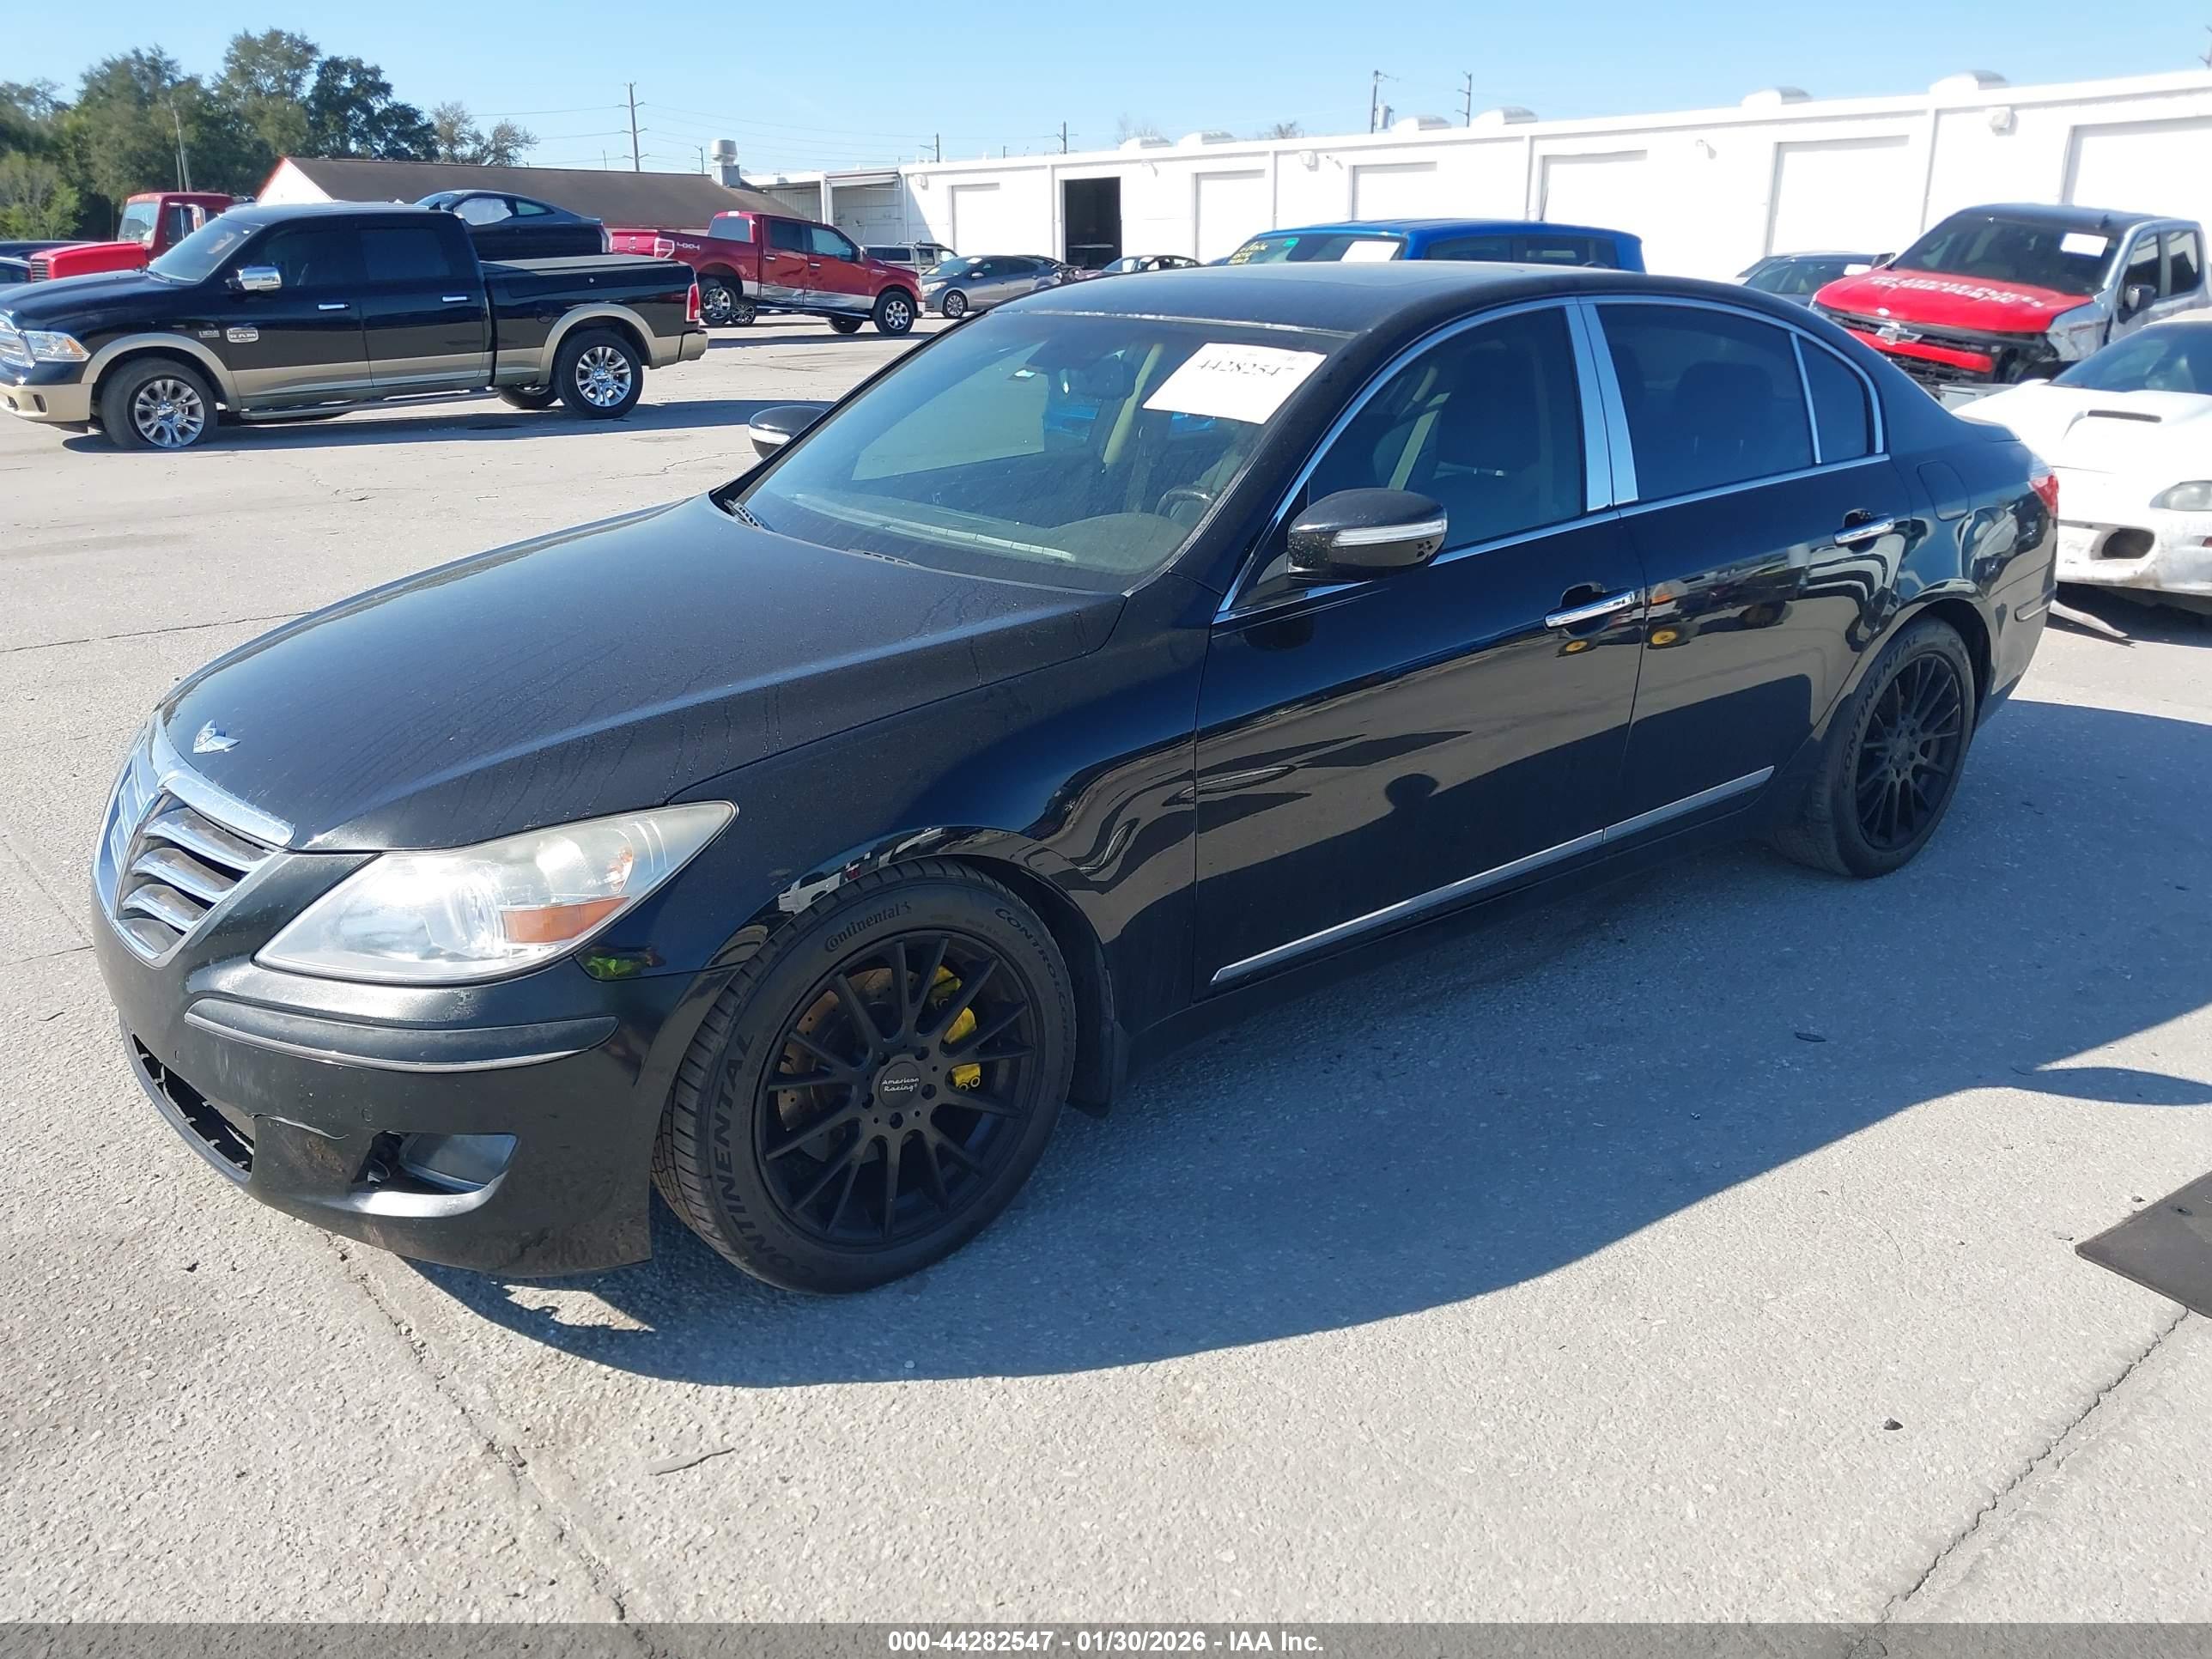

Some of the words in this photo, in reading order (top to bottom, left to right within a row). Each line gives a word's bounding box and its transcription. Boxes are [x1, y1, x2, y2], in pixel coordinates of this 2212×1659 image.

[1197, 358, 1296, 378] 4428254
[824, 902, 901, 953] Continental
[882, 1077, 920, 1085] American
[713, 1033, 816, 1278] CONTINENTAL
